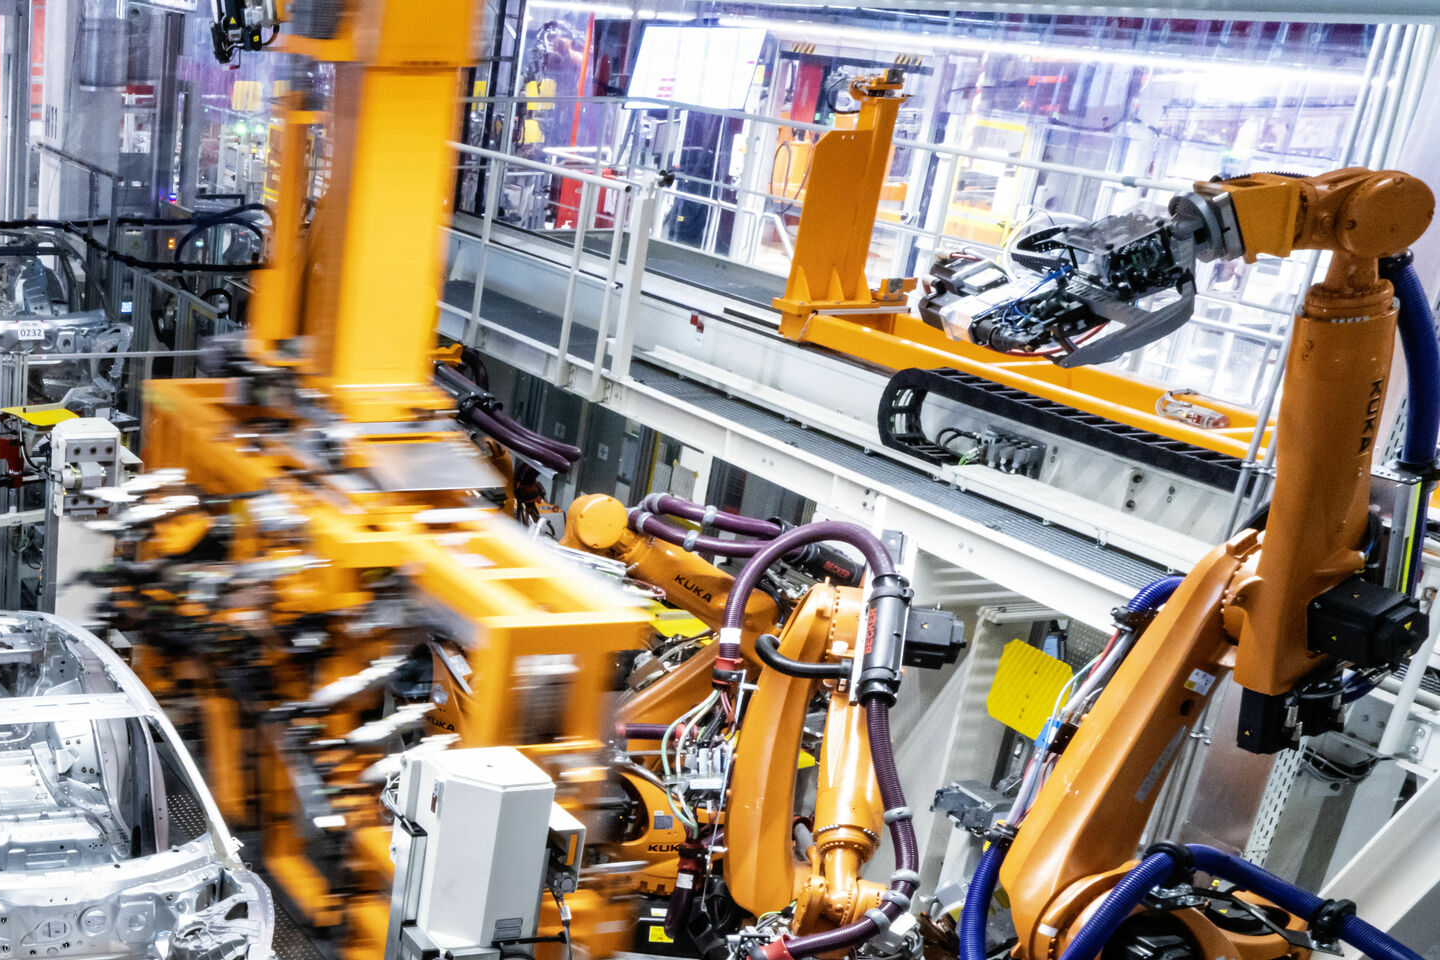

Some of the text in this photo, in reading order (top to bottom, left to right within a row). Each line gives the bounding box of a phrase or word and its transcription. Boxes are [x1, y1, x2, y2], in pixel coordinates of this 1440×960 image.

[20, 329, 42, 337] 0232
[1359, 378, 1383, 453] KUKA
[674, 574, 713, 603] KUKA
[864, 608, 877, 655] BECKER
[648, 844, 680, 852] KUK
